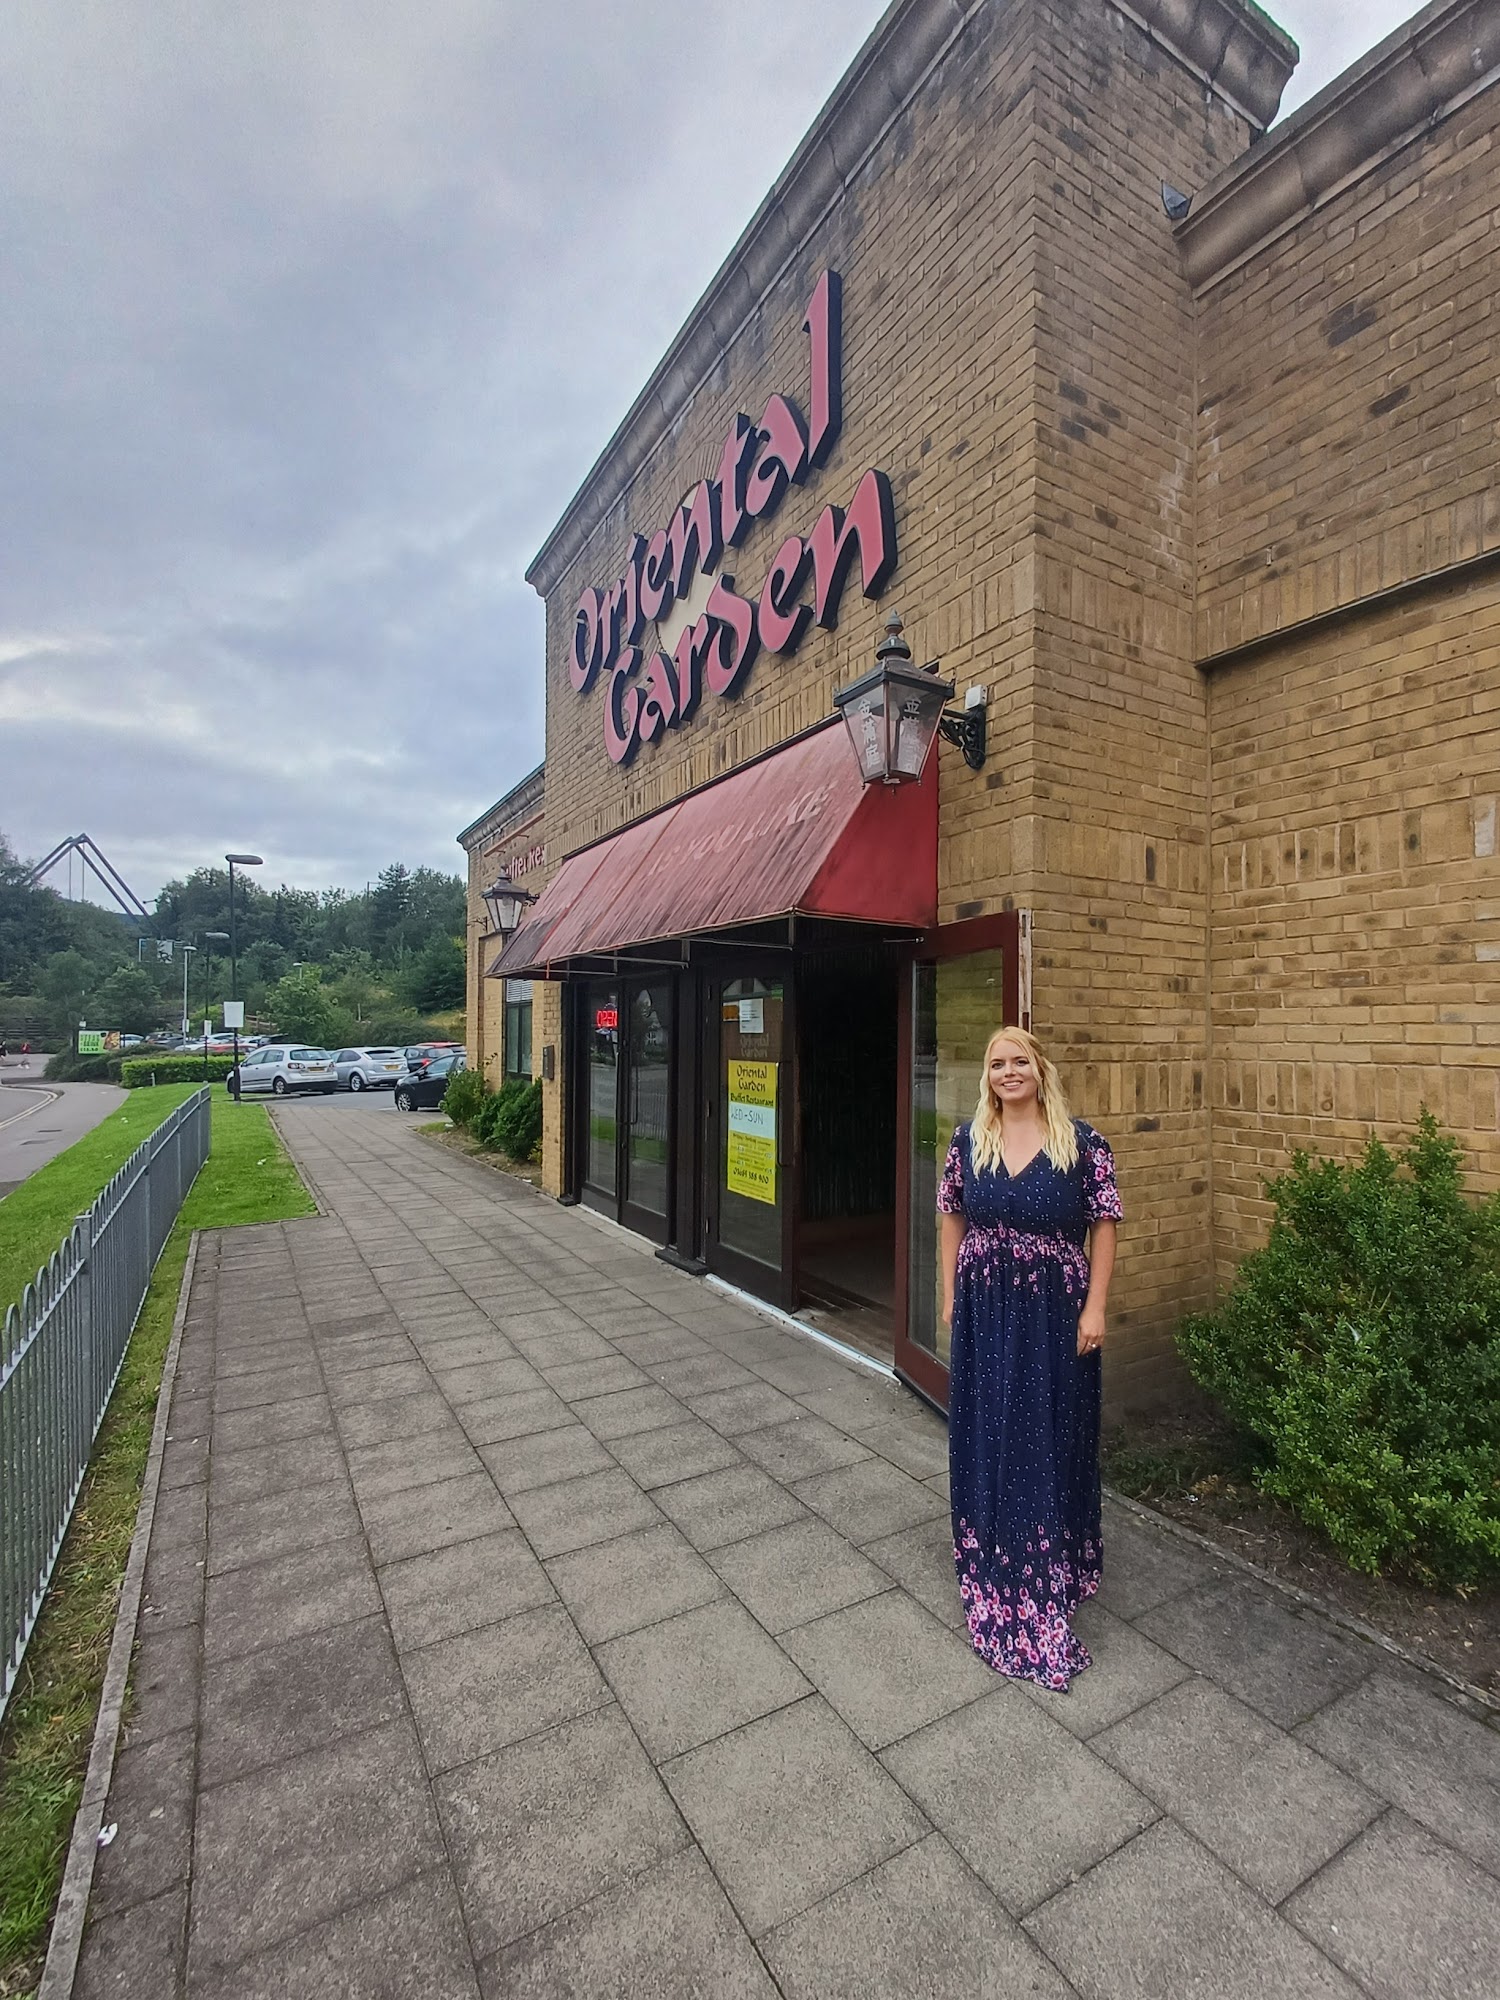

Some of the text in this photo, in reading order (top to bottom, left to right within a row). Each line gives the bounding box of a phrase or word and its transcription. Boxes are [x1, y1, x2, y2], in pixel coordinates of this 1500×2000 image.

[569, 269, 842, 693] Oriental
[604, 468, 897, 764] Garden
[506, 855, 528, 880] uffet
[737, 1064, 768, 1079] Oriental
[738, 1077, 766, 1092] Garden
